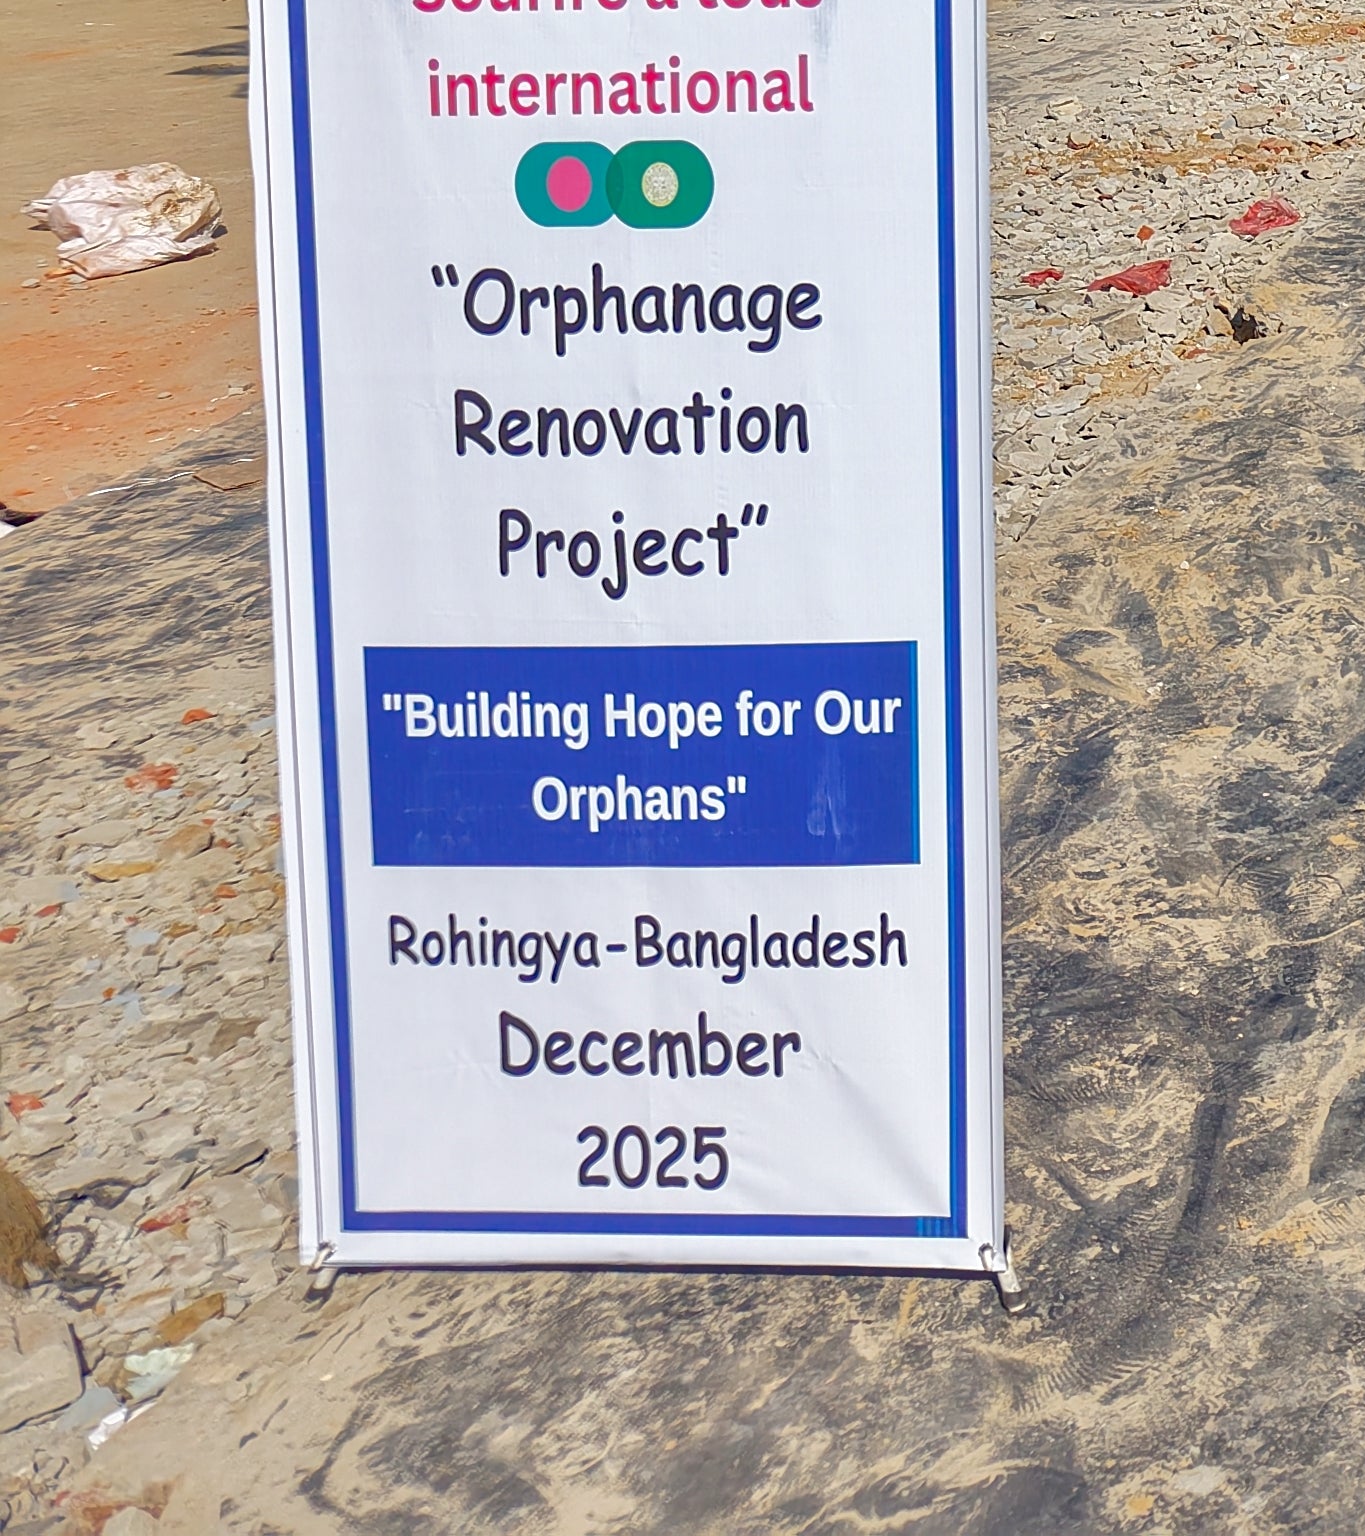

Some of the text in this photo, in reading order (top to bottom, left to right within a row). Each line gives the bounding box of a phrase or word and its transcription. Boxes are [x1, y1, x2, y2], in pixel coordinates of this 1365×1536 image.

[428, 55, 813, 117] international
[454, 386, 809, 458] Renovation
[382, 690, 902, 750] "Building Hope for Our
[532, 774, 746, 833] Orphans"
[389, 912, 908, 984] Rohingya-Bangladesh
[499, 1010, 801, 1080] December
[577, 1125, 729, 1191] 2025
